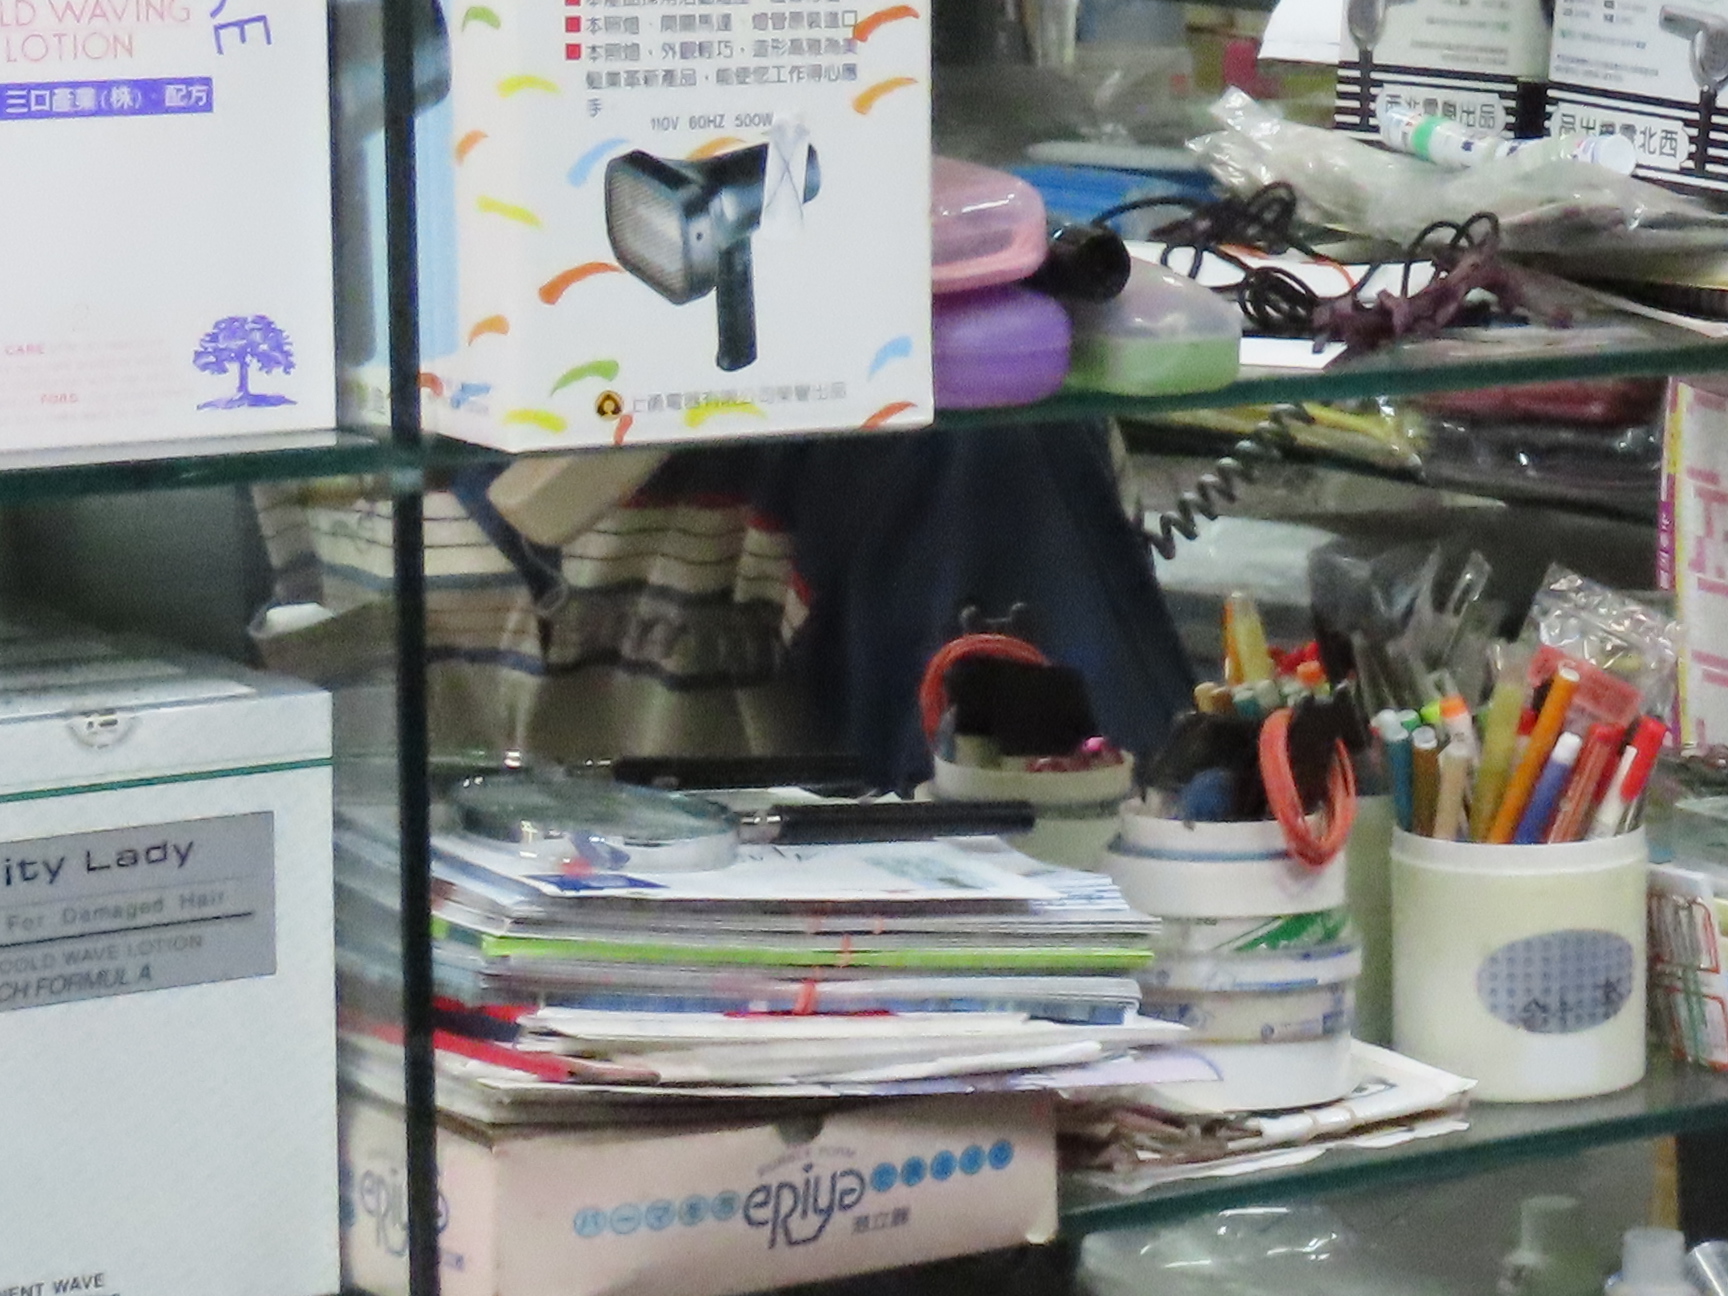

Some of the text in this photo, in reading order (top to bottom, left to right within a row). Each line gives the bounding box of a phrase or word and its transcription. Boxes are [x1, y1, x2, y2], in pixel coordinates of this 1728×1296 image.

[6, 32, 134, 63] LOTION
[86, 840, 195, 875] Lady
[53, 1272, 105, 1295] WAVE
